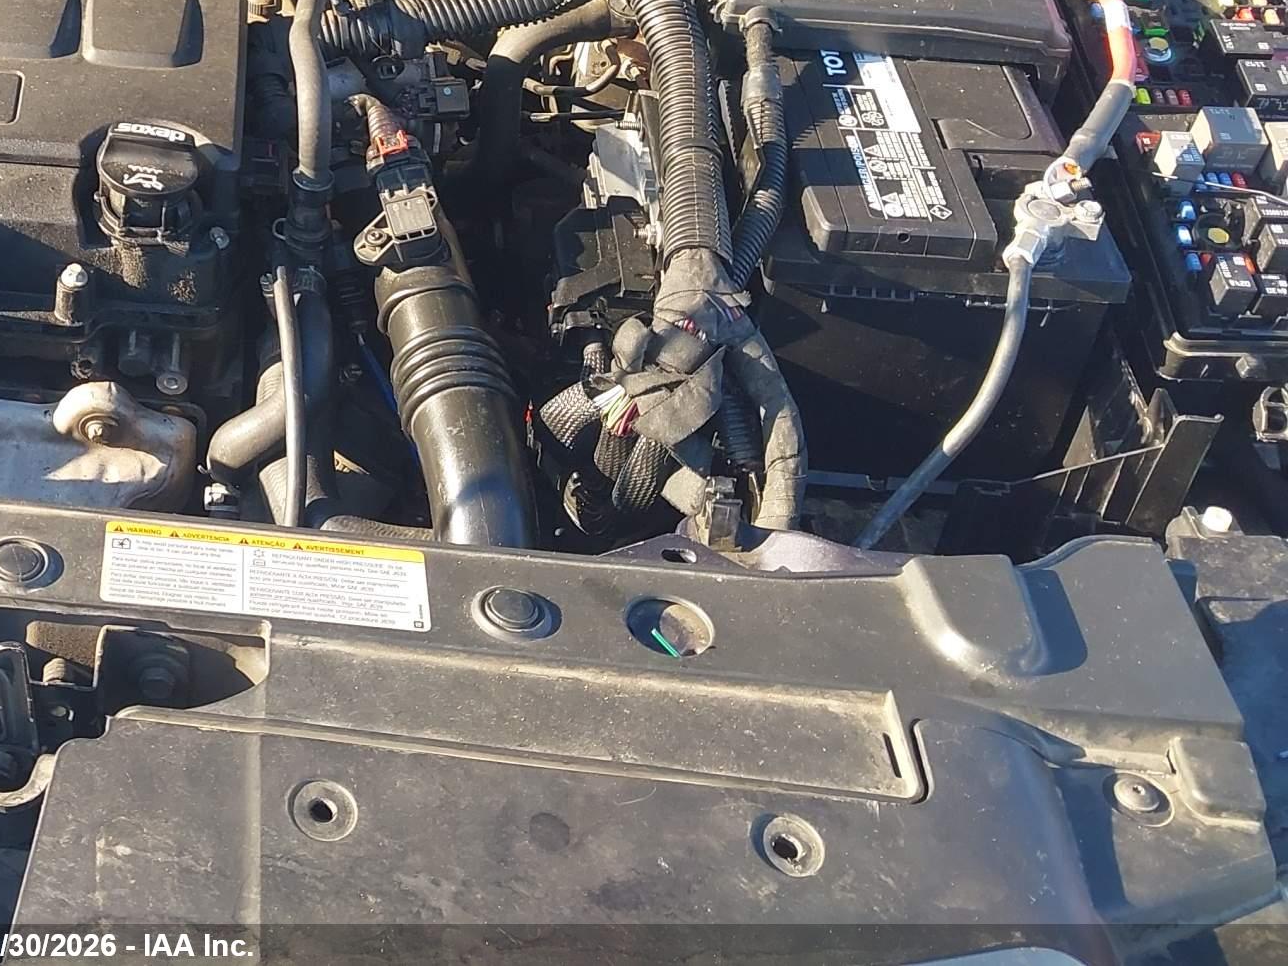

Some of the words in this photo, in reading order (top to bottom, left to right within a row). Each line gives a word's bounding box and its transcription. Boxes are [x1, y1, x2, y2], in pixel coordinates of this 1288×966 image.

[113, 122, 186, 142] dexos
[127, 526, 162, 536] WARNING
[183, 532, 230, 542] ADVERTENCIA
[305, 544, 365, 555] AVERTISSEMENT
